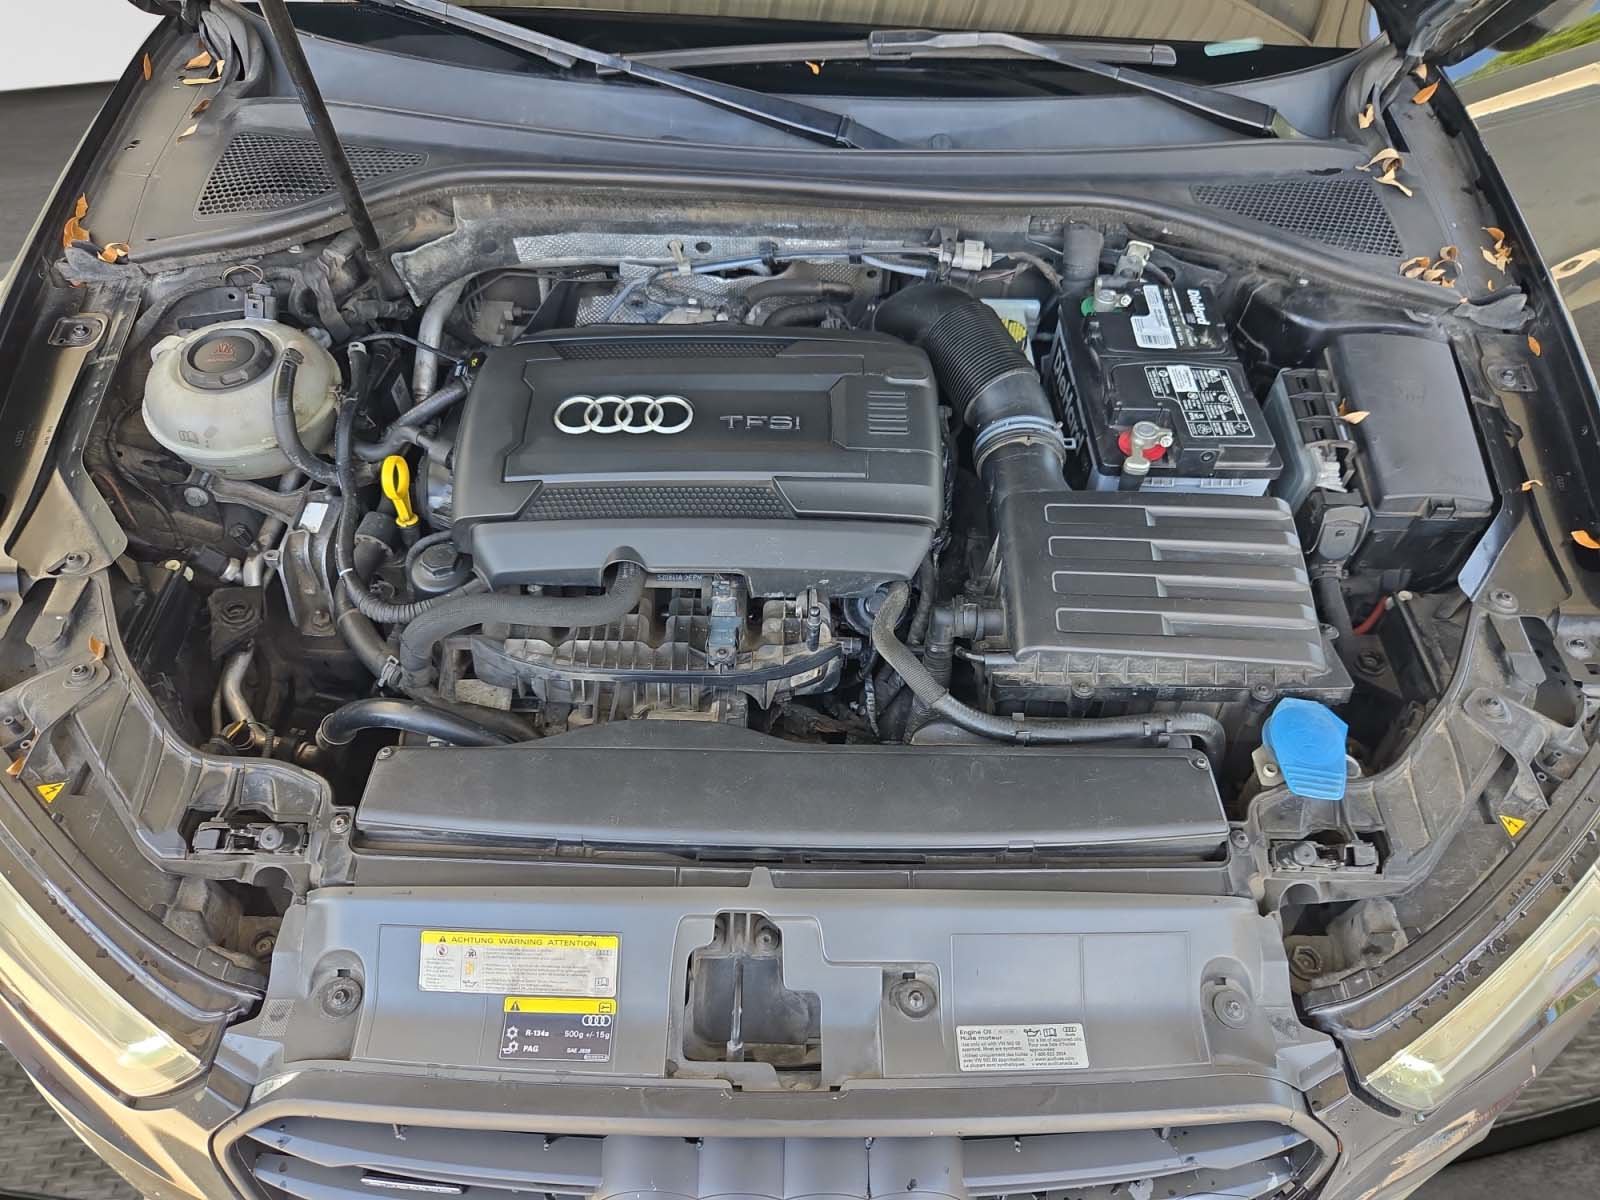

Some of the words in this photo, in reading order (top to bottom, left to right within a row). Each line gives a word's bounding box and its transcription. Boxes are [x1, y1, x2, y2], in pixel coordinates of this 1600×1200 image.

[1186, 289, 1211, 326] DieHard
[1053, 346, 1085, 456] DieHard
[719, 415, 800, 430] TFSI
[451, 935, 494, 945] ACHTUNG
[499, 937, 543, 946] WARNING
[547, 939, 598, 948] ATTENTION
[525, 1029, 550, 1038] R-134a
[564, 1030, 584, 1040] 500g
[523, 1045, 540, 1053] PAG
